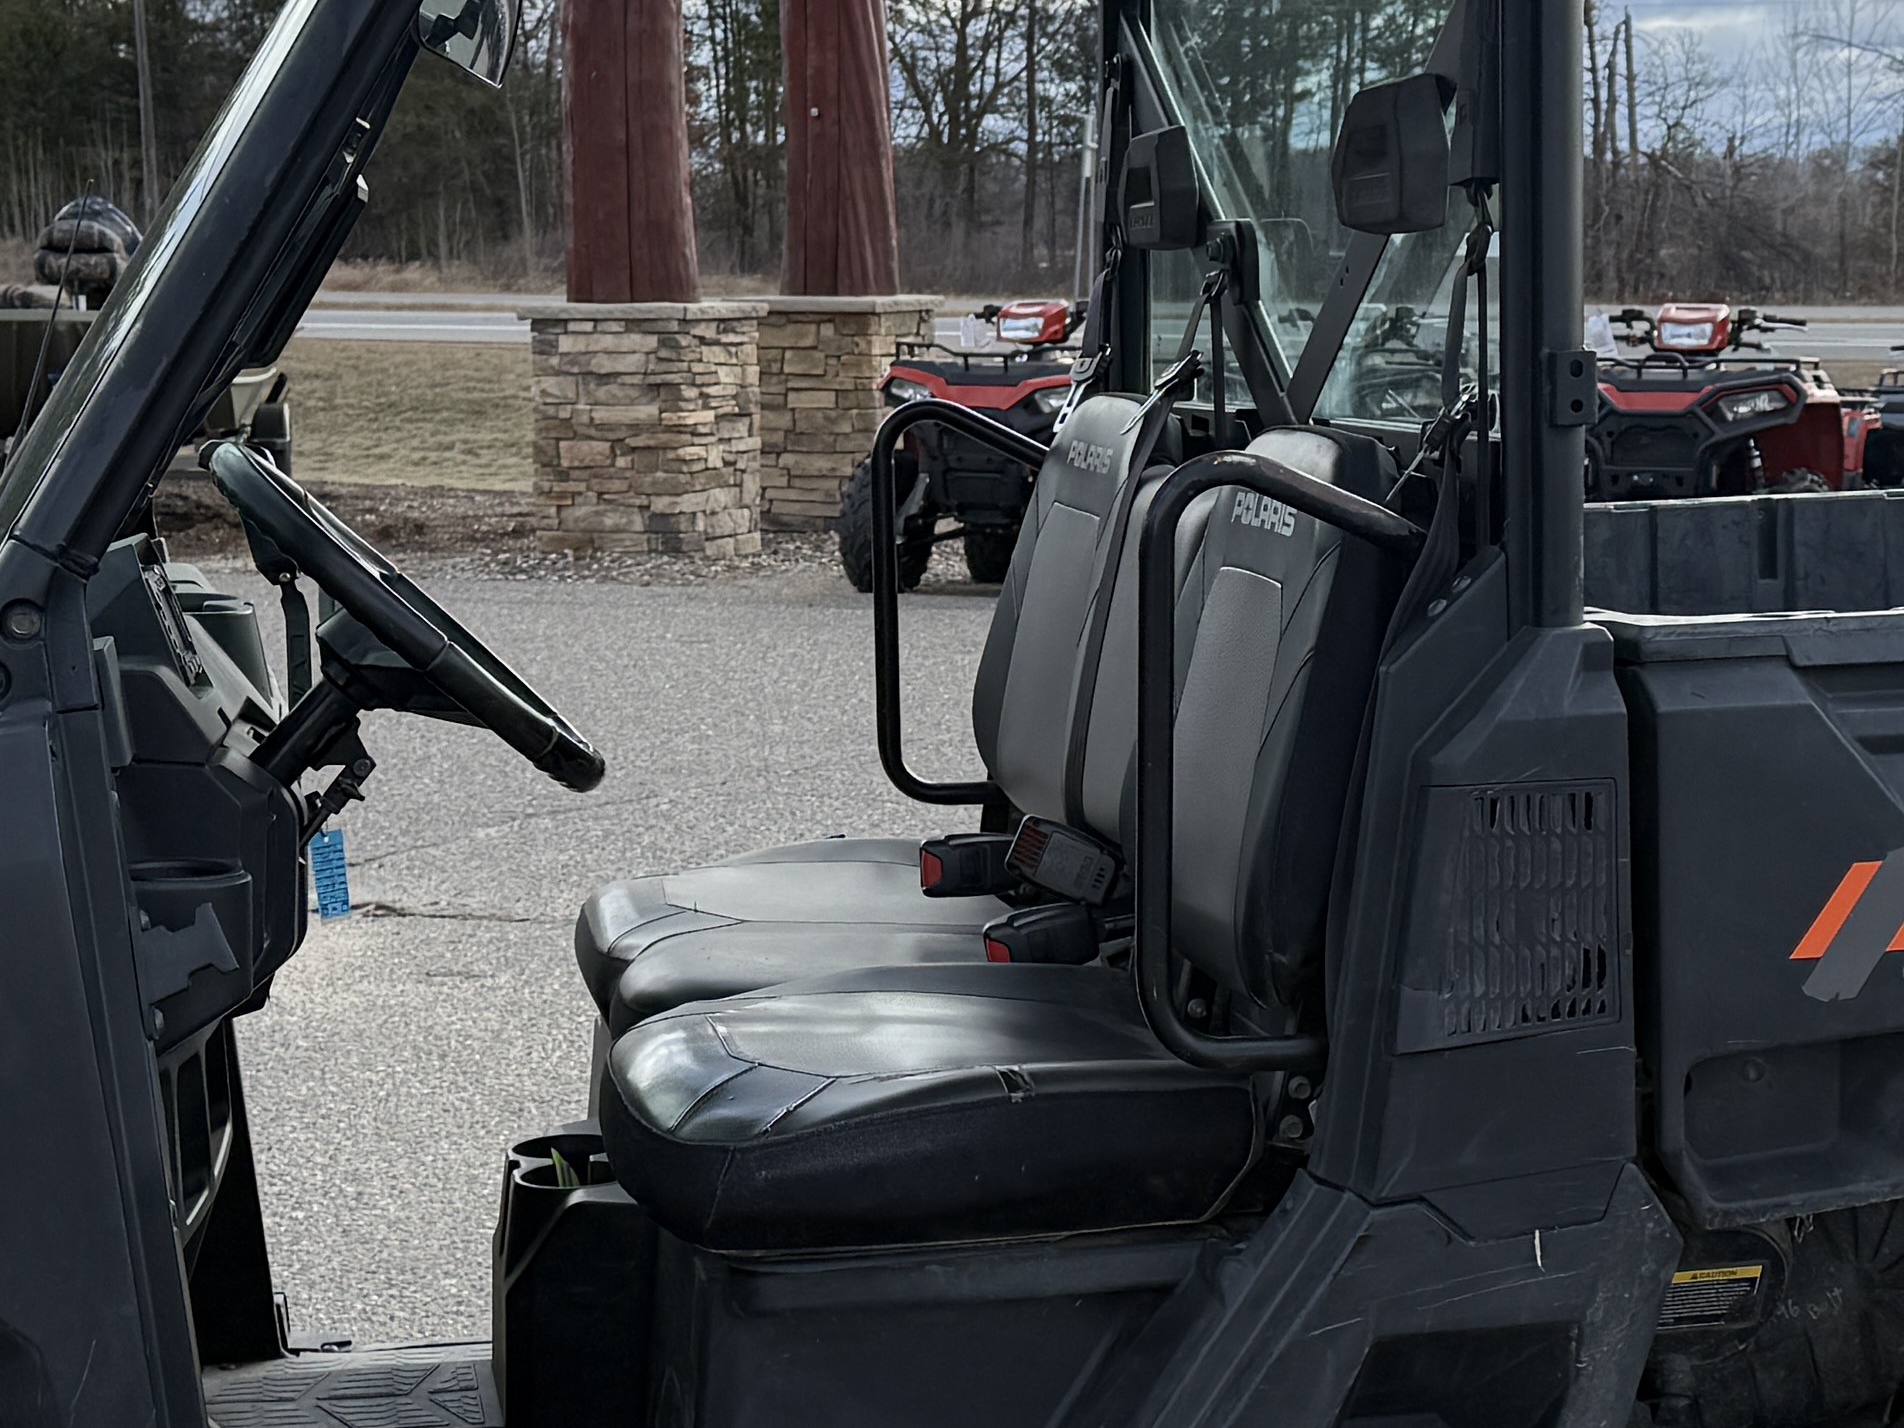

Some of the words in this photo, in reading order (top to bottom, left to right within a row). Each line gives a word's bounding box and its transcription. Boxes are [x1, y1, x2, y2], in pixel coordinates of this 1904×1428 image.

[1067, 439, 1114, 474] POLARIS
[1231, 492, 1298, 537] POLARIS
[1698, 1269, 1738, 1280] CAUTION
